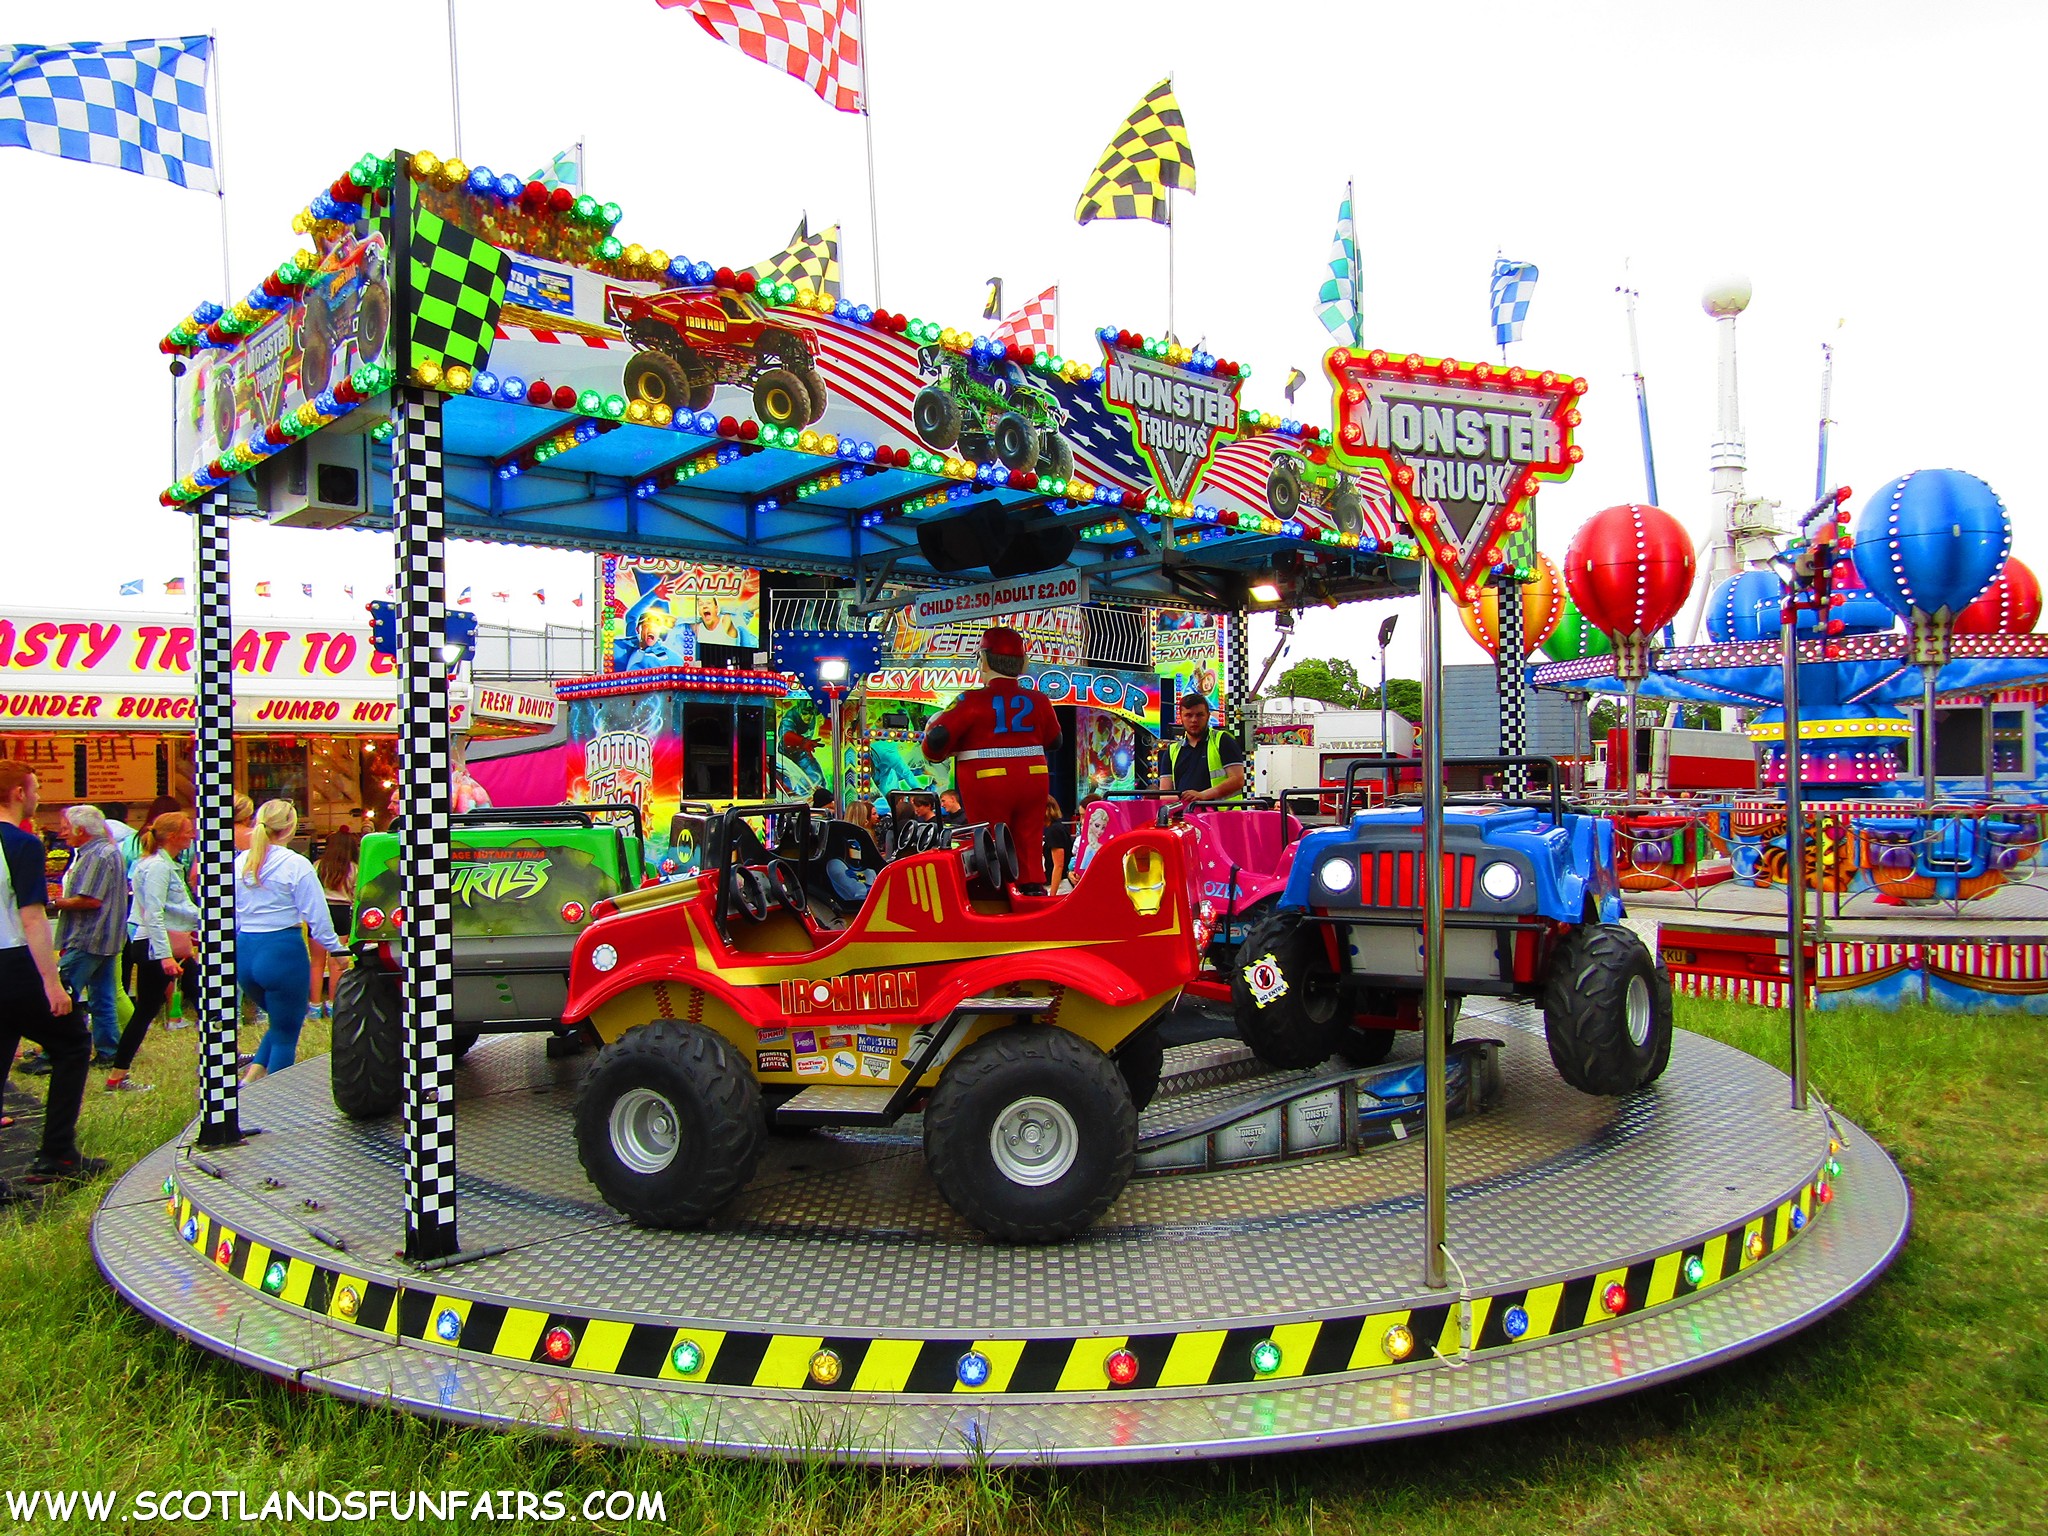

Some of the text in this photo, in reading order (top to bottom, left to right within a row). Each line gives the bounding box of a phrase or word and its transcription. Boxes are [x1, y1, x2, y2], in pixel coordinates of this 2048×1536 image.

[1108, 364, 1236, 429] MONSTER
[1138, 412, 1208, 459] TRUCKS
[1350, 395, 1562, 464] MONSTER
[1403, 456, 1506, 505] TRUCK
[675, 575, 742, 596] ALL!
[919, 600, 953, 617] CHILD
[993, 585, 1036, 606] ADULT
[135, 626, 290, 674] TRAT
[302, 629, 357, 674] TO
[1190, 628, 1216, 645] THE
[257, 700, 340, 720] JUMBO
[353, 702, 396, 721] HOT
[480, 690, 555, 719] FRESH DONUTS
[992, 694, 1034, 734] 12
[586, 733, 651, 779] ROTOR
[591, 773, 617, 802] IT'S
[473, 850, 514, 859] MUTANT
[516, 850, 545, 859] NINJA
[780, 971, 919, 1015] IRON MAN
[1260, 985, 1285, 1002] NO ENTRY
[859, 1036, 897, 1047] MONSTER
[761, 1061, 789, 1069] MATER
[1300, 1108, 1333, 1120] MONSTER
